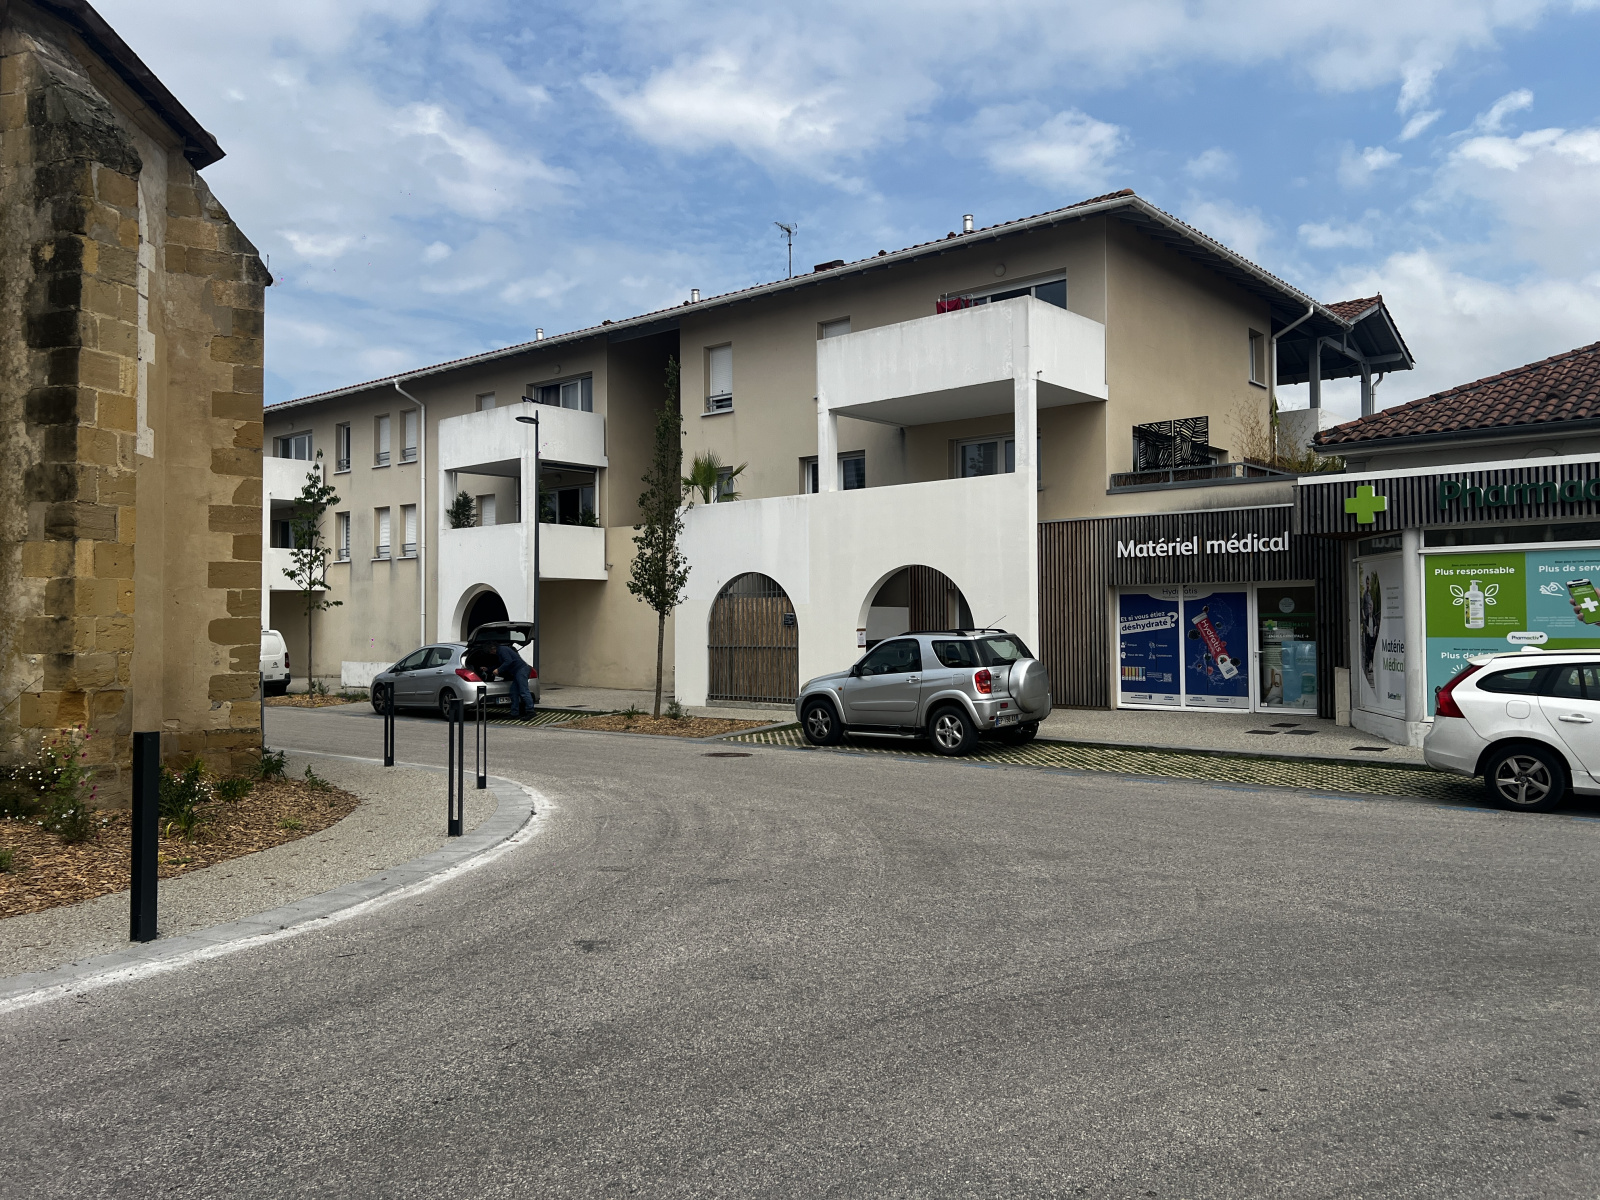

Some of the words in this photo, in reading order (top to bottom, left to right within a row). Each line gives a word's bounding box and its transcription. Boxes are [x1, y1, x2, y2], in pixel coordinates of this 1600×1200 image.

[1117, 535, 1198, 558] Matériel
[1206, 531, 1289, 554] médical
[1434, 568, 1454, 576] Plus
[1456, 566, 1515, 576] responsable
[1538, 565, 1560, 573] Plus
[1562, 564, 1576, 572] de
[1121, 618, 1168, 631] déshydraté
[1201, 619, 1222, 652] Hydratis
[1382, 638, 1405, 654] Matérie
[1441, 651, 1461, 660] Plus
